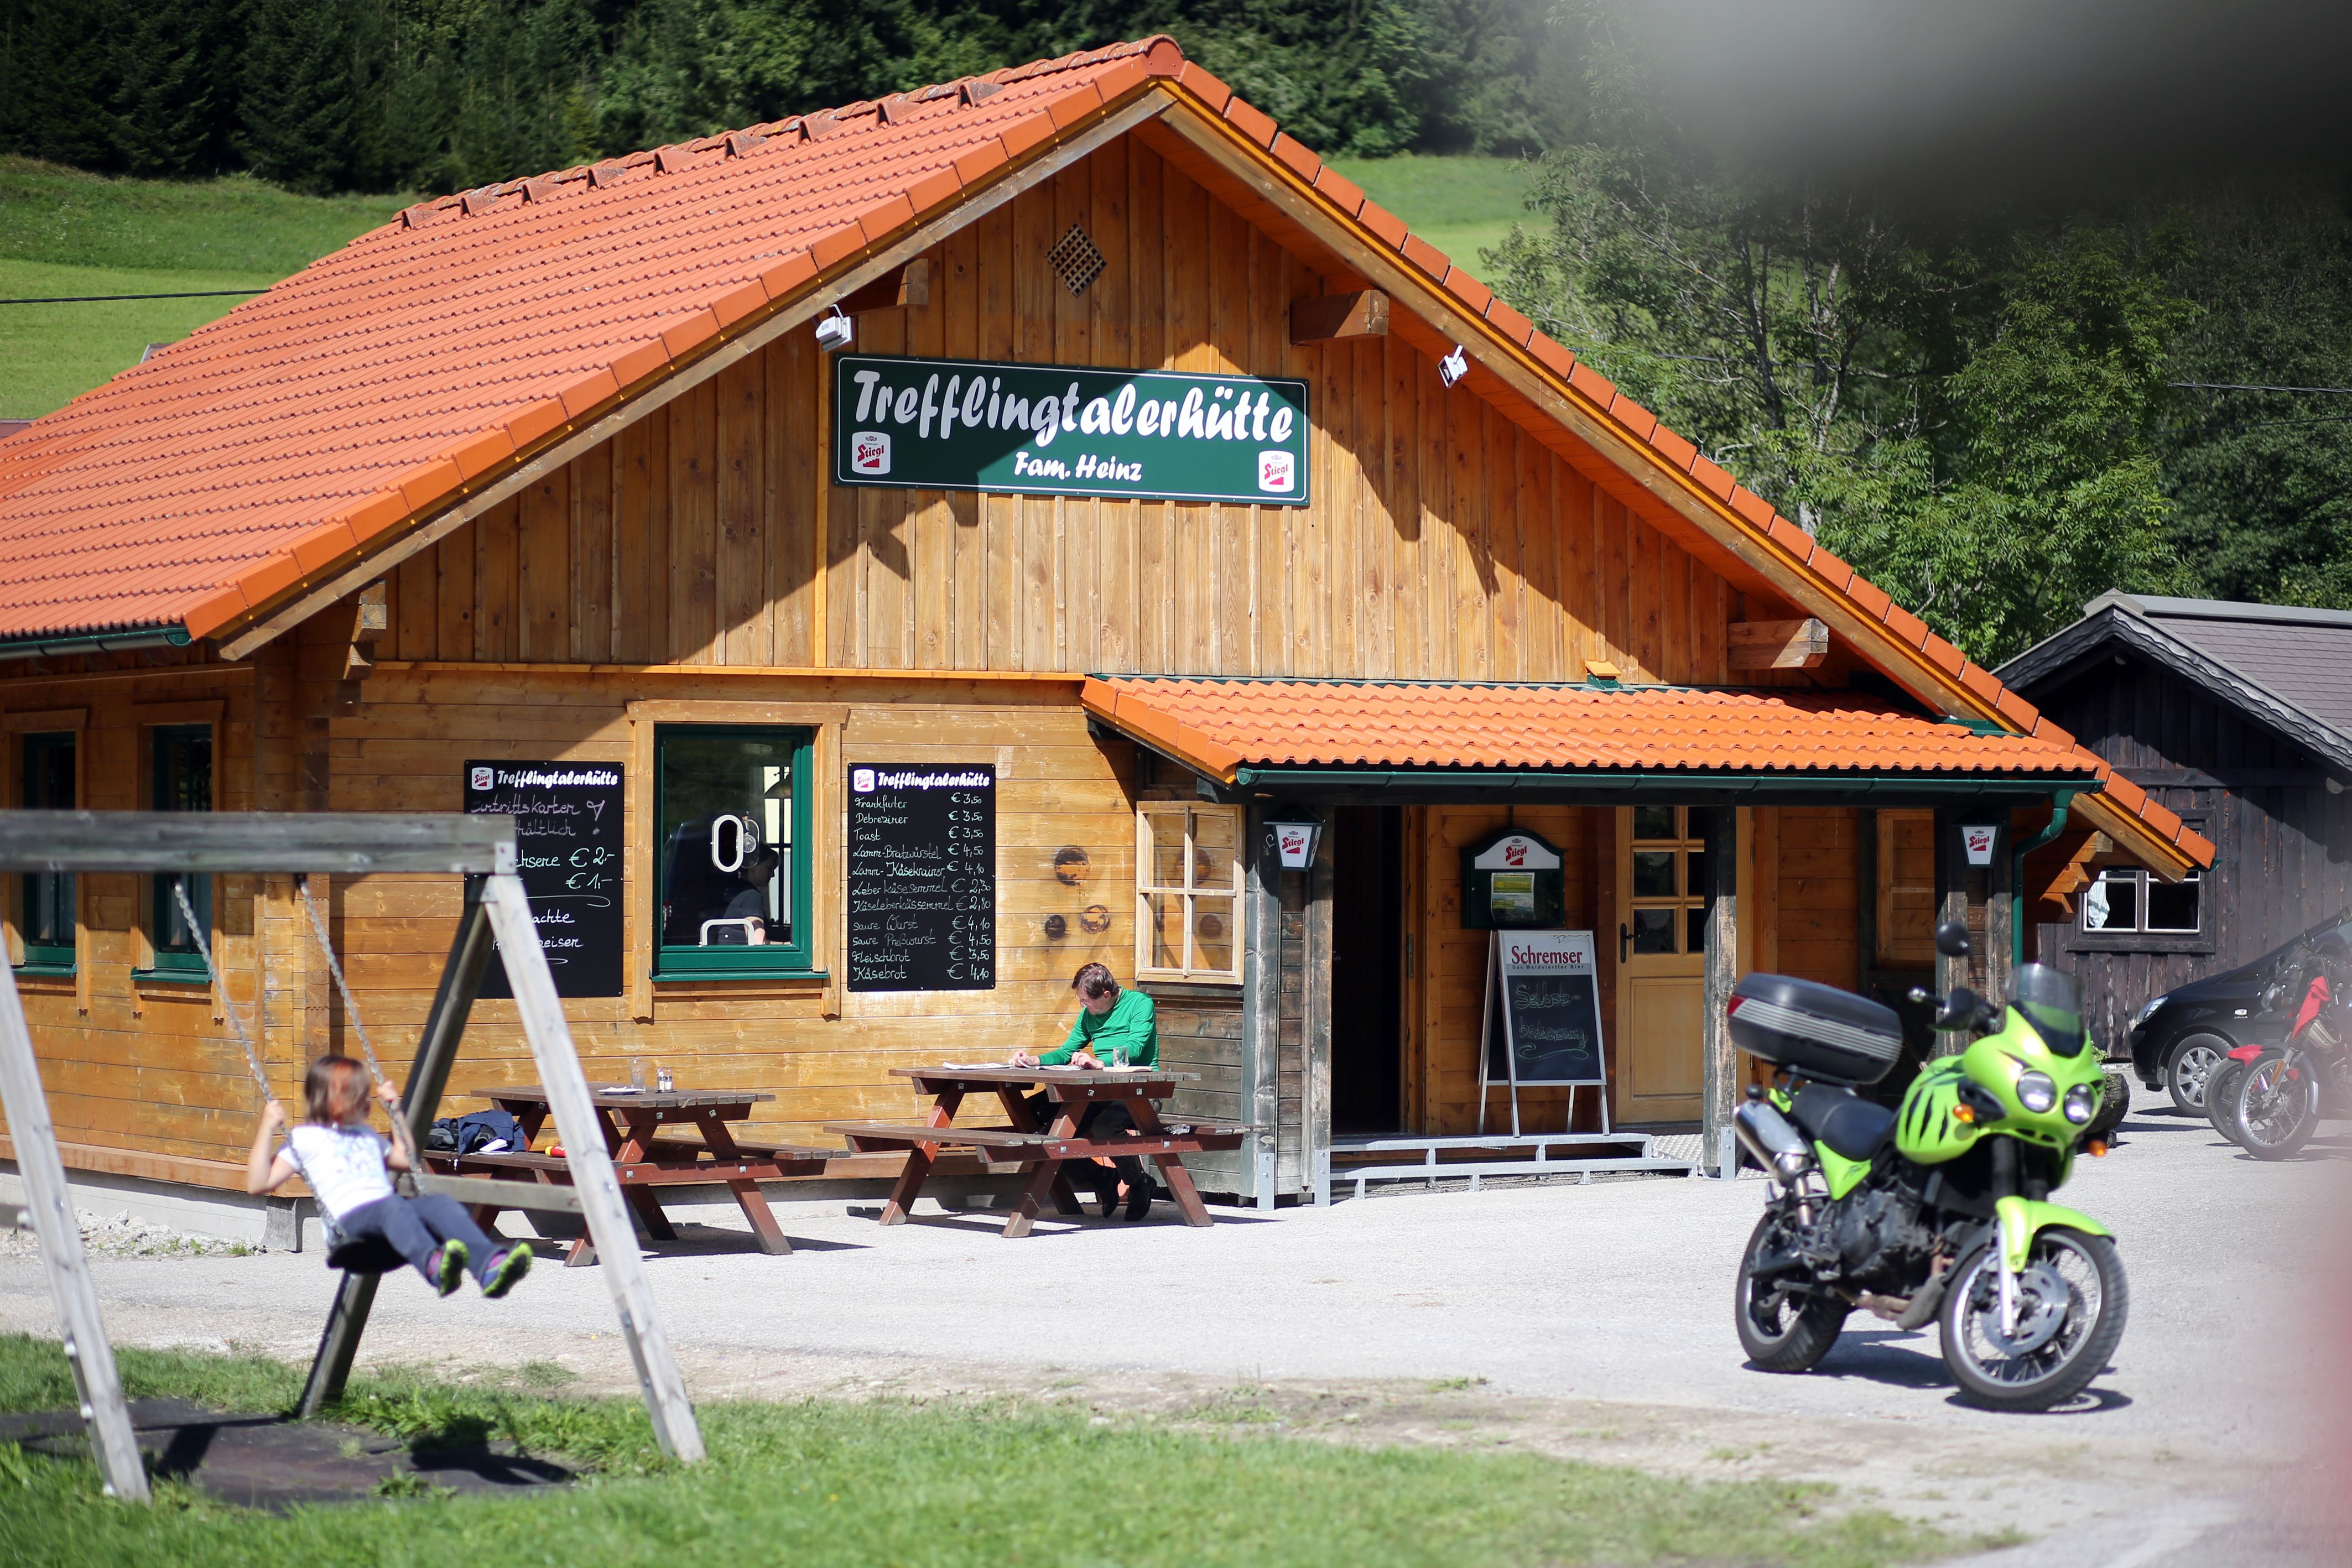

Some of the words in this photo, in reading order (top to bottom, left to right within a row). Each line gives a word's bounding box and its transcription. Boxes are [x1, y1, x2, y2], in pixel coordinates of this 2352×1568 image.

[854, 370, 1294, 447] Trefflingtalerhütte
[857, 444, 884, 462] Stiegl
[1014, 451, 1071, 478] Fam.
[1075, 454, 1143, 481] Heinz
[1265, 463, 1288, 480] Stiegl
[475, 774, 490, 784] Stiegl
[497, 770, 618, 789] Trefflingtalerhütte
[878, 772, 990, 790] Trefflingtalerhütte
[855, 795, 907, 812] Frankfurter
[951, 792, 961, 803] €
[963, 793, 982, 804] 3,50
[856, 812, 908, 824] Debreziner
[948, 810, 959, 821] €
[963, 810, 983, 821] 3,50
[516, 819, 576, 837] hältlich
[854, 827, 881, 841] Toast
[948, 826, 959, 838] €
[963, 827, 984, 839] 3,50
[948, 843, 960, 855] €
[964, 843, 984, 857] 4,50
[1282, 836, 1304, 850] Stiegl
[1969, 836, 1990, 848] Stiegl
[516, 849, 560, 868] chsene
[569, 847, 590, 868] €
[1506, 846, 1527, 862] Stiegl
[946, 861, 959, 872] €
[965, 862, 984, 876] 4,10
[565, 872, 586, 889] €
[951, 878, 965, 892] €
[955, 895, 968, 911] €
[969, 896, 991, 911] 2,80
[531, 909, 575, 924] achte
[886, 914, 919, 930] Wurst
[952, 915, 966, 929] €
[968, 915, 990, 931] 4,10
[948, 930, 962, 944] €
[969, 933, 991, 946] 4,50
[852, 948, 910, 963] Fleischbrot
[949, 946, 964, 960] €
[969, 947, 990, 961] 3,50
[1511, 945, 1583, 964] Schremser
[853, 965, 907, 981] Käsebrot
[946, 963, 964, 979] €
[971, 964, 989, 980] 4,10
